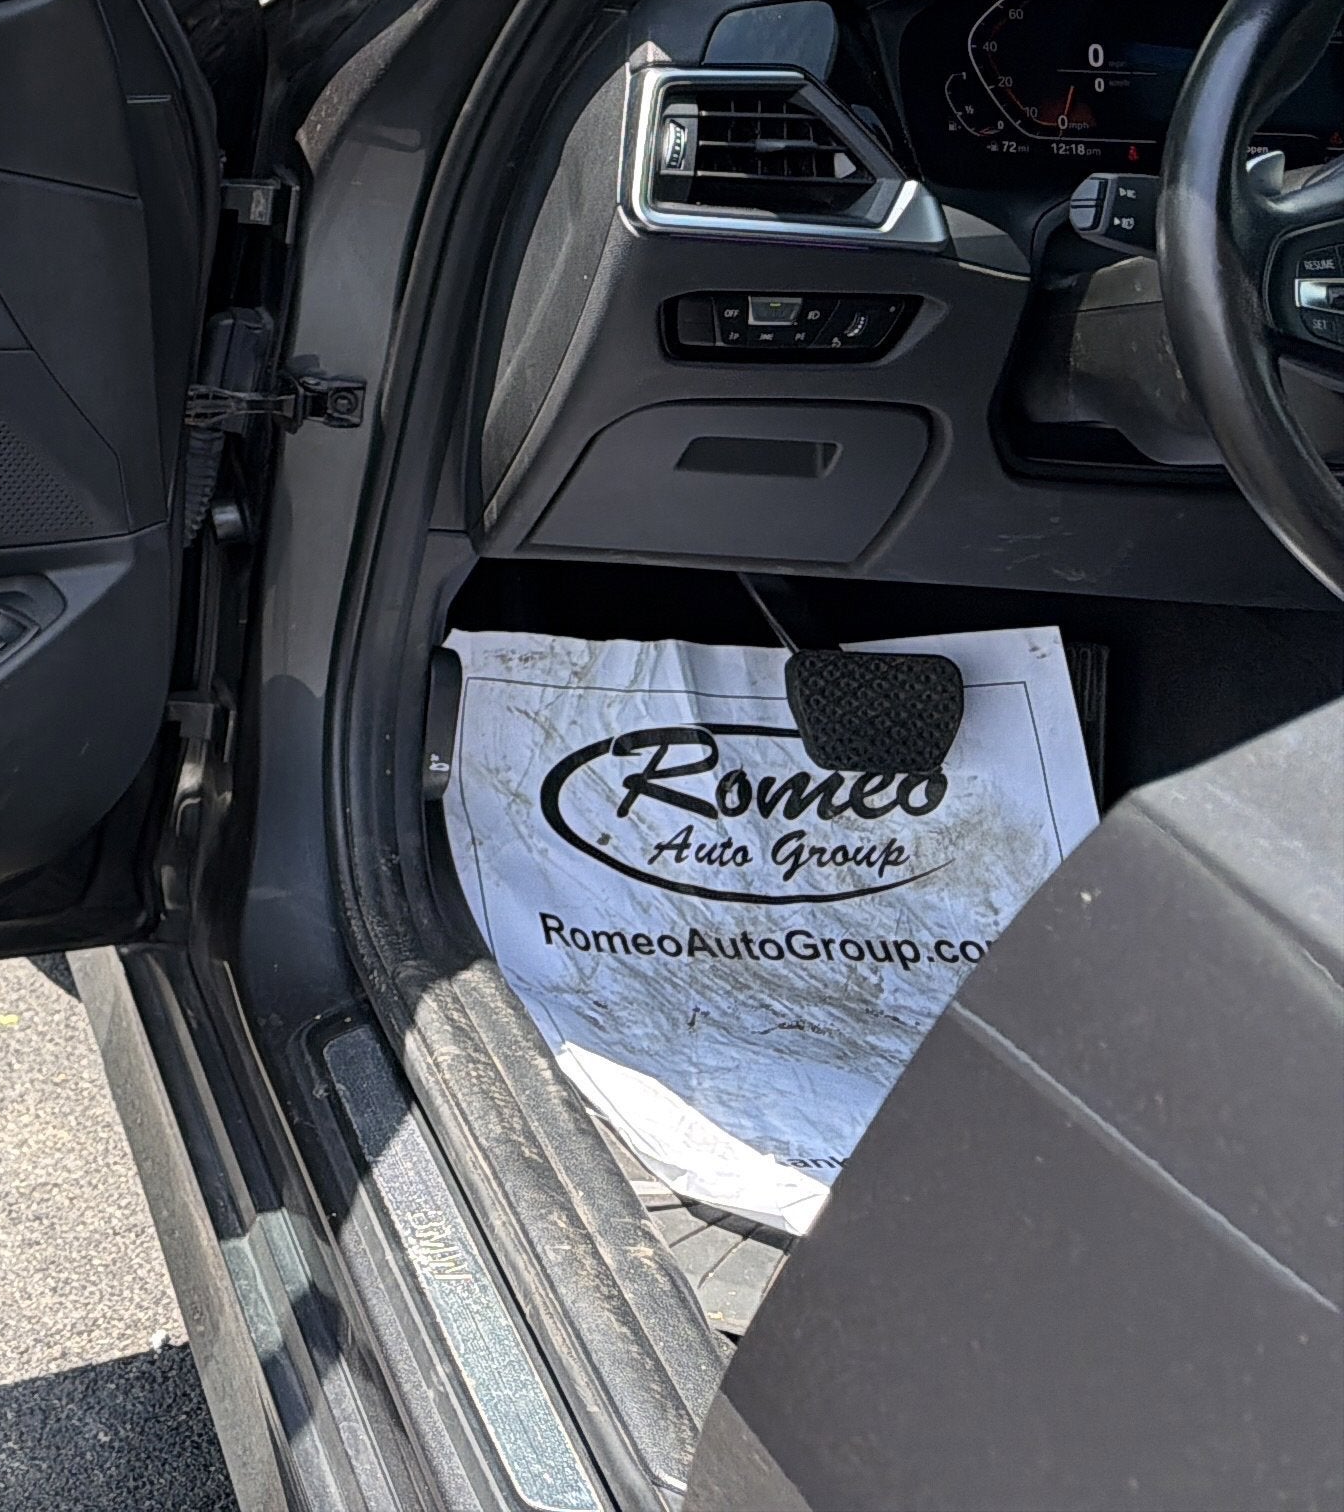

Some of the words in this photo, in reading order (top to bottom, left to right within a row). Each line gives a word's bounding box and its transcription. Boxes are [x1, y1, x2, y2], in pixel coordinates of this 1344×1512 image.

[1008, 8, 1024, 20] 60
[982, 40, 998, 52] 40
[1088, 43, 1104, 68] 0
[998, 76, 1013, 88] 20
[1094, 78, 1105, 93] 0
[1024, 106, 1038, 118] 10
[1057, 115, 1068, 129] 0
[1068, 122, 1089, 131] mph
[1002, 140, 1017, 153] 72
[1051, 142, 1085, 156] 12:18
[1086, 148, 1102, 157] pm
[1303, 259, 1335, 271] RESUME
[724, 309, 739, 317] OFF
[1312, 319, 1327, 329] SET
[612, 725, 949, 821] Romeo
[648, 823, 753, 867] Auto
[772, 828, 911, 882] Group
[539, 910, 991, 970] RomeoAutoGroup.co
